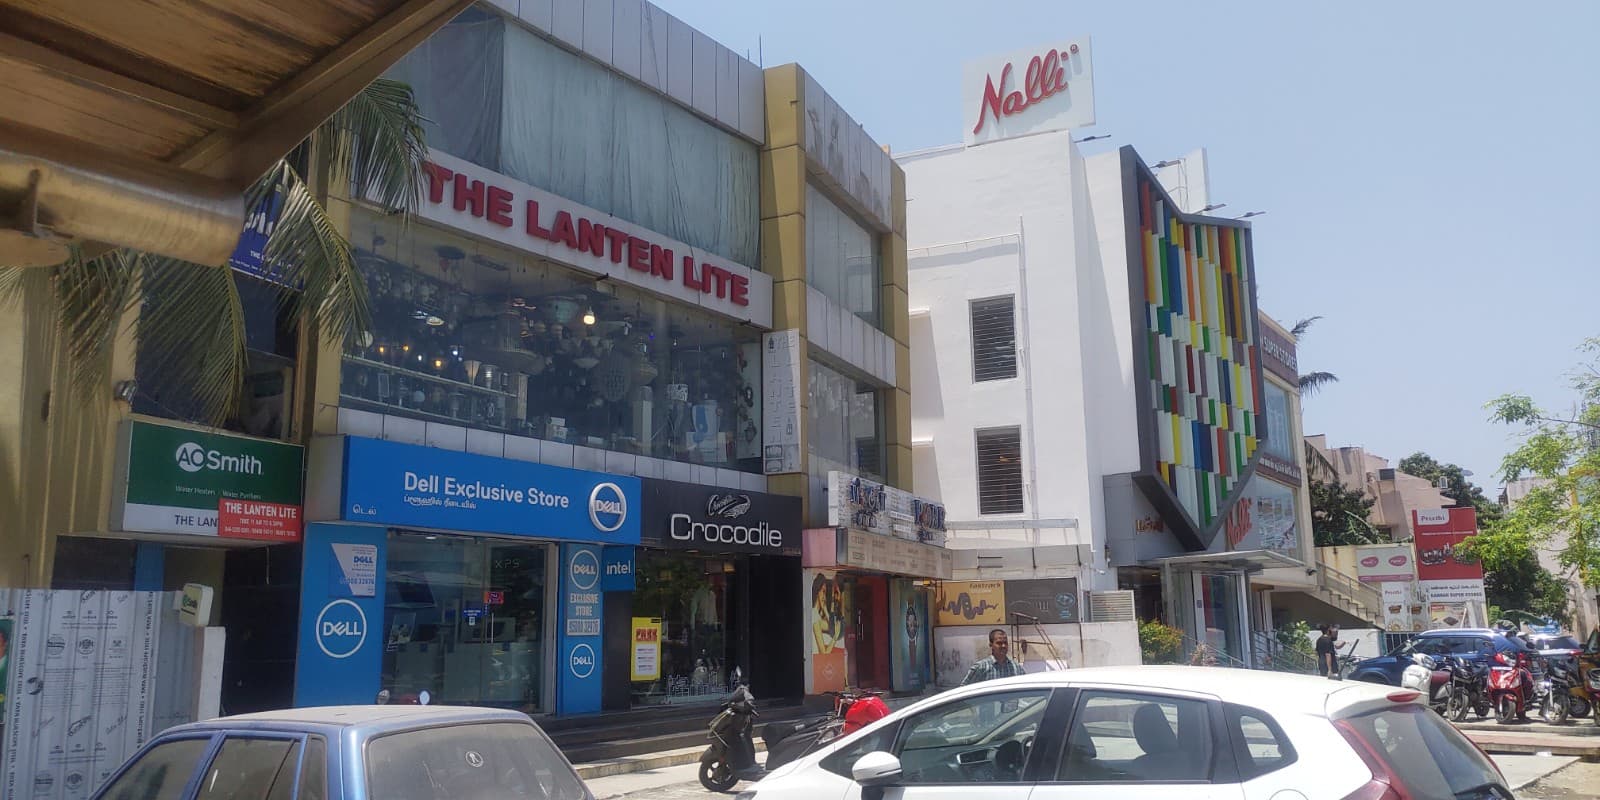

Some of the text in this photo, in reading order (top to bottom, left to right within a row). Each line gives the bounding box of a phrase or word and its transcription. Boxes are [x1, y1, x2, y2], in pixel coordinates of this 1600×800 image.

[973, 48, 1069, 135] Nalli
[423, 161, 749, 306] THE LANTEN LITE
[404, 471, 569, 508] Dell Exclusive Store
[225, 502, 297, 519] THE LANTEN LITE
[594, 499, 623, 514] DELL
[174, 514, 218, 528] THE LAN
[671, 513, 782, 548] Crocodile
[353, 556, 374, 564] DELL
[606, 560, 631, 575] intel
[573, 564, 596, 575] DELL
[322, 620, 362, 637] DELL
[573, 656, 592, 665] DELL
